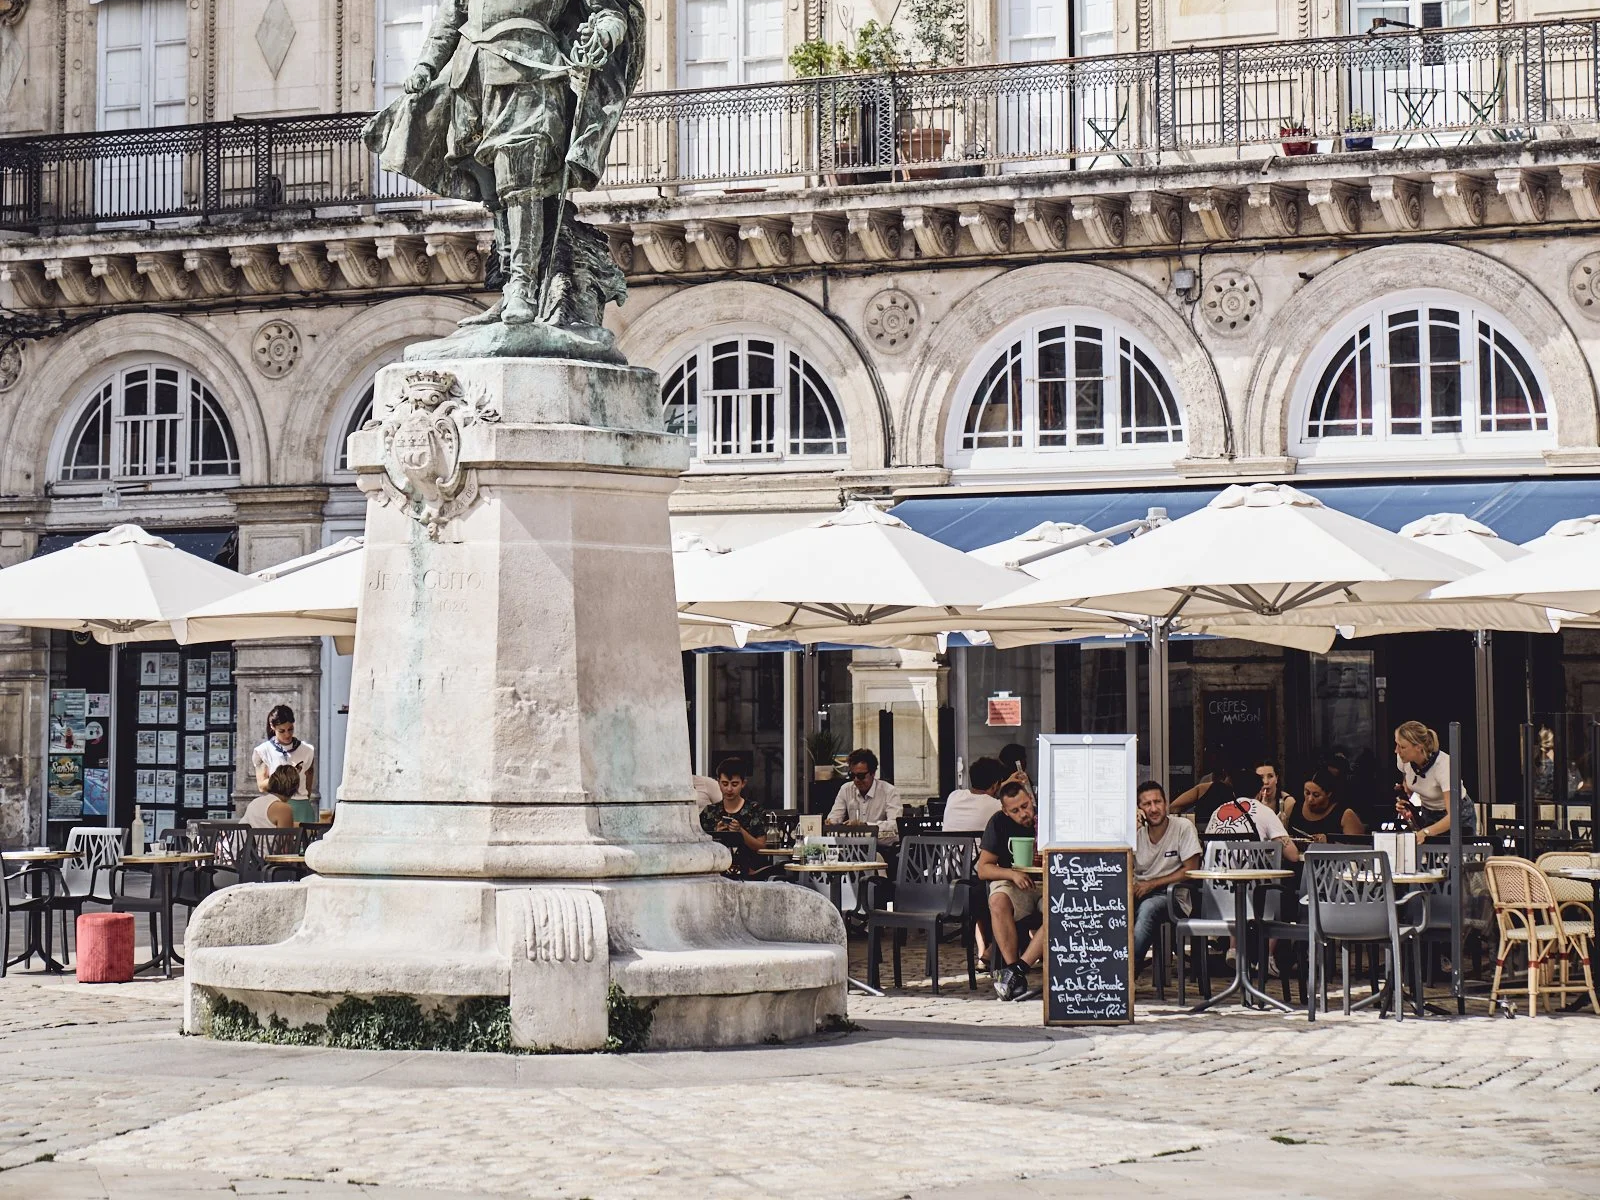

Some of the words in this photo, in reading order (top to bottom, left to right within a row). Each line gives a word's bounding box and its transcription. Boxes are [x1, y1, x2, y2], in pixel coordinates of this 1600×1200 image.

[422, 569, 493, 591] GUITO
[1222, 707, 1261, 725] MAISON
[1050, 853, 1069, 874] Nos
[1069, 856, 1122, 882] Suggestions
